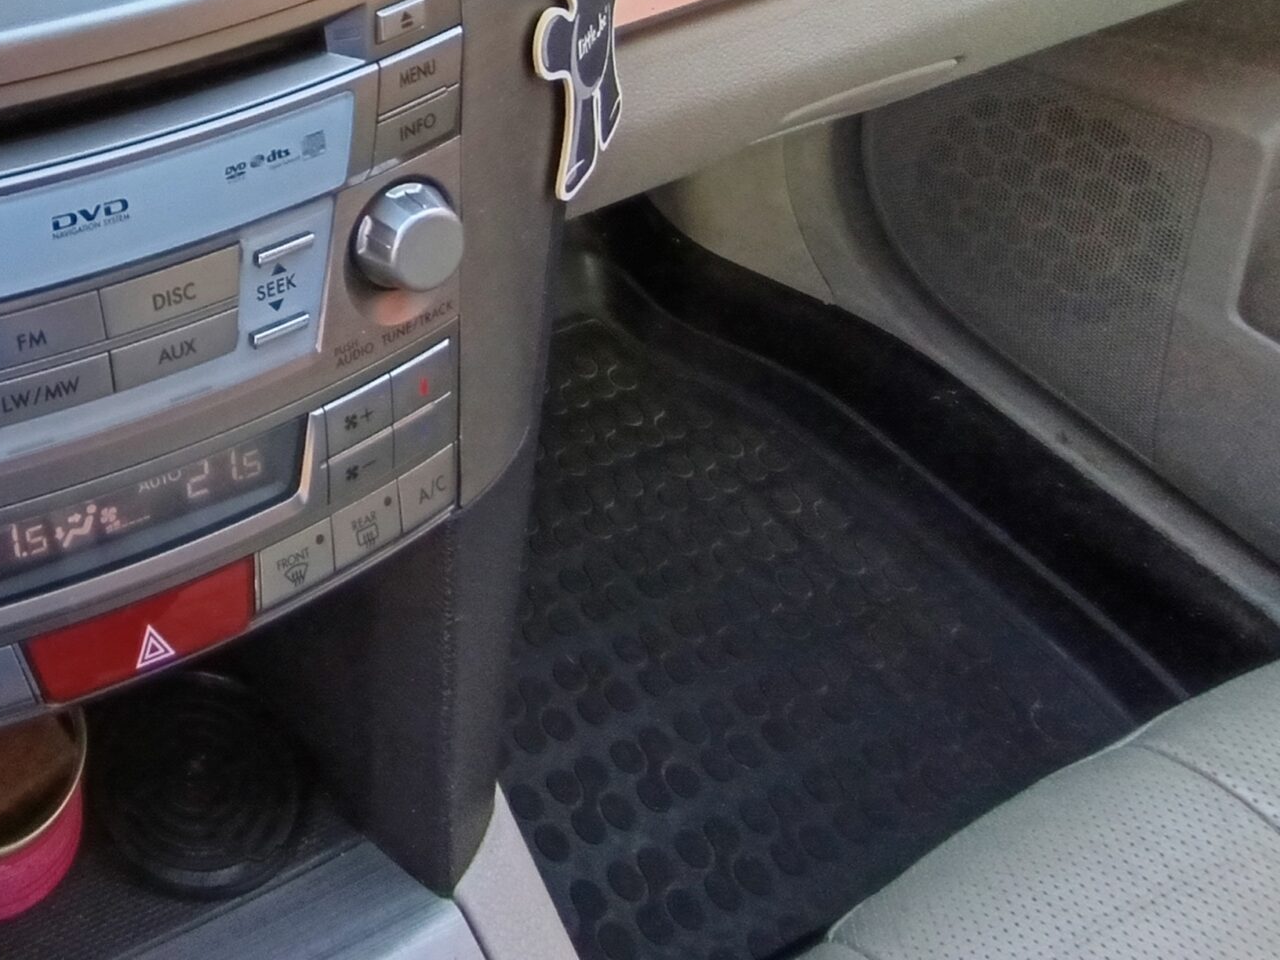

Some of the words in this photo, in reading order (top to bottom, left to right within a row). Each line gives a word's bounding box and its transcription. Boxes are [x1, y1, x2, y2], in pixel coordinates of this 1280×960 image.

[399, 59, 436, 88] MENU
[400, 113, 437, 140] INFO
[225, 162, 246, 175] DVD
[267, 148, 291, 163] dts
[52, 198, 129, 231] DVD
[152, 282, 197, 312] DISC
[256, 273, 297, 302] SEEK
[16, 329, 47, 351] FM
[158, 339, 197, 365] AUX
[336, 342, 374, 368] AUDIO
[1, 376, 80, 414] LW/MW
[419, 475, 447, 505] A/C
[351, 511, 377, 531] REAR
[276, 547, 310, 571] FRONT
